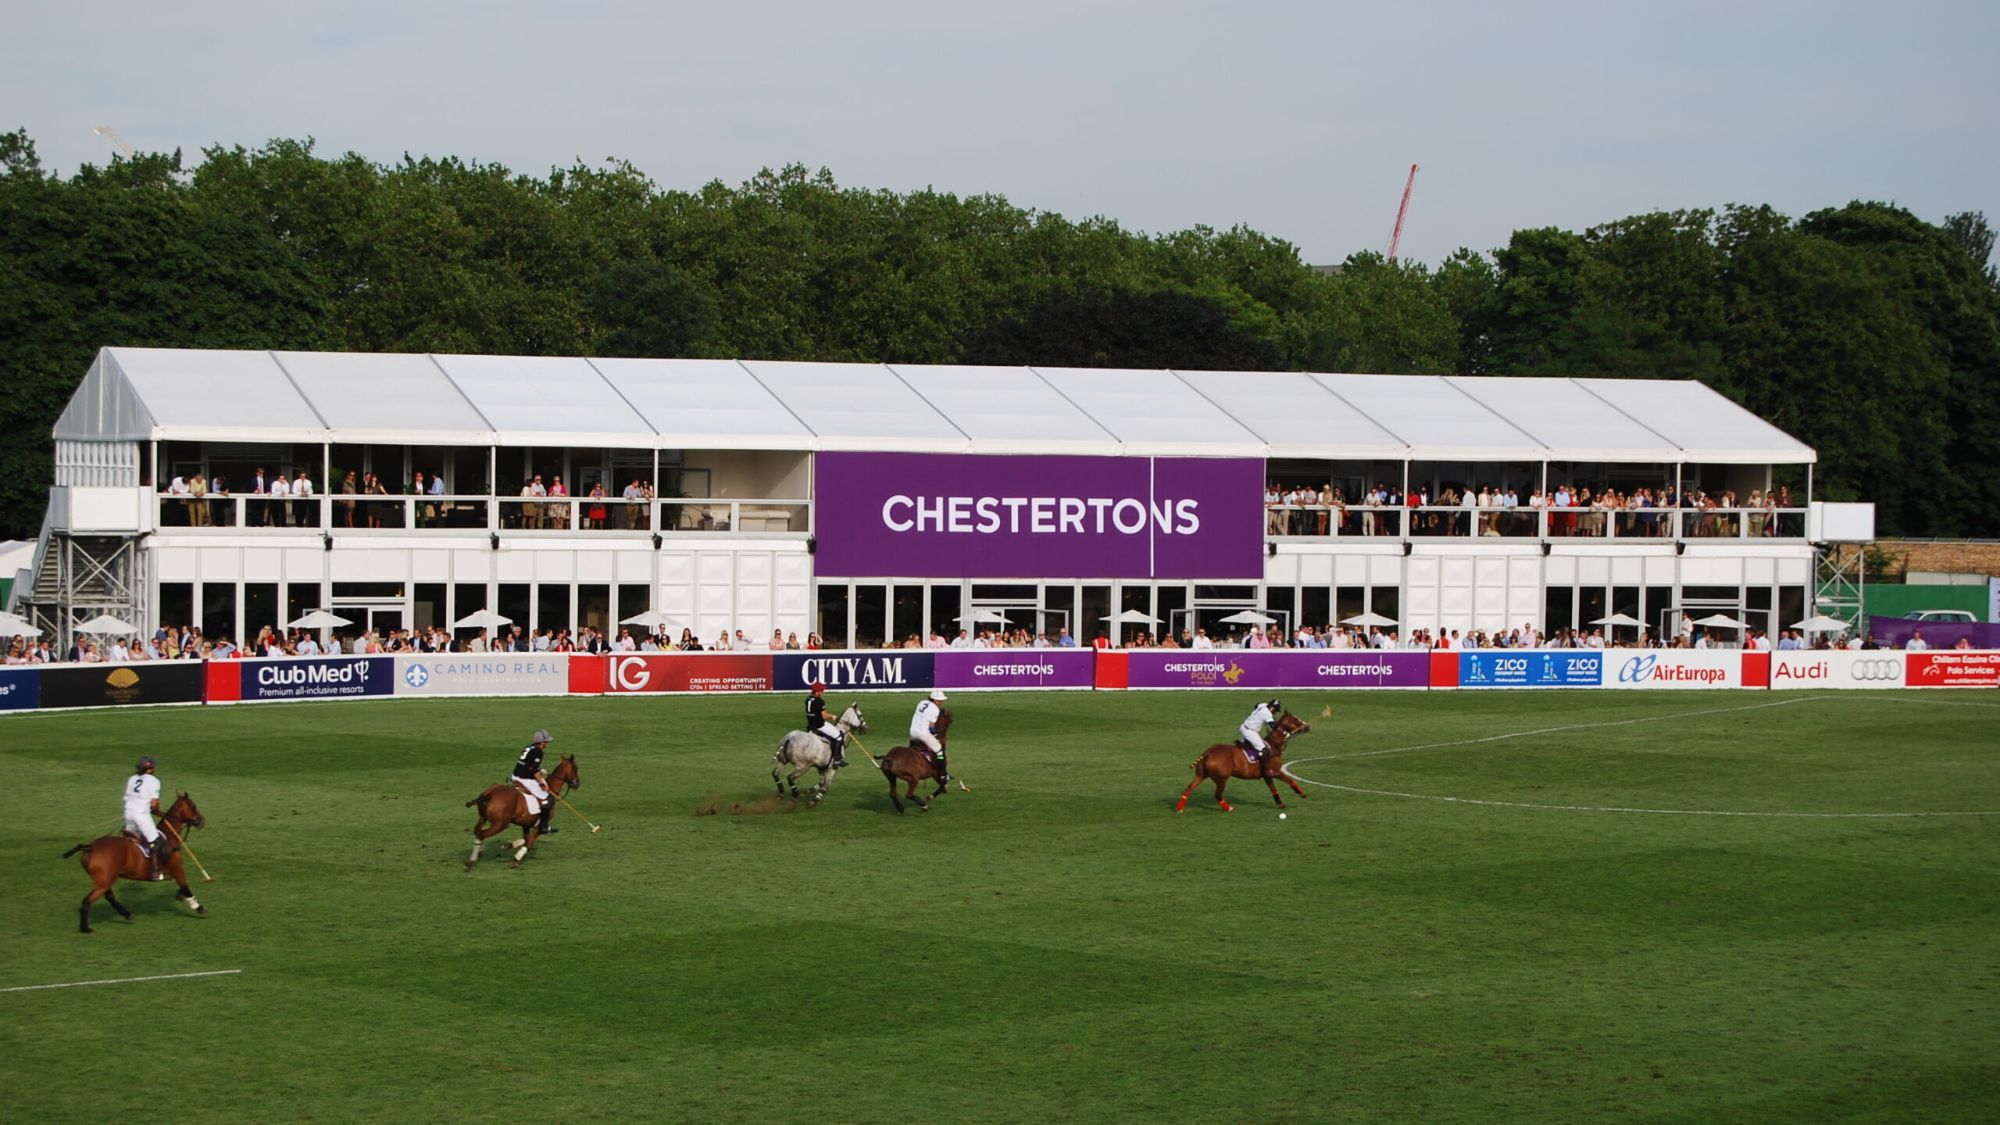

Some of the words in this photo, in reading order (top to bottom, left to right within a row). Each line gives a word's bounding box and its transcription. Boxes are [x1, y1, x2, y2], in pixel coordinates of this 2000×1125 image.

[882, 494, 1200, 535] CHESTERTONS
[434, 663, 507, 675] CAMINO
[514, 663, 560, 674] REAL
[973, 664, 1054, 676] CHESTERTONS
[1164, 663, 1226, 673] CHESTERTONS
[1317, 664, 1393, 676] CHESTERTONS
[1495, 659, 1528, 671] ZICO
[1566, 659, 1599, 671] ZICO
[1775, 661, 1828, 679] Audi
[258, 665, 306, 686] Club
[308, 663, 353, 683] Med
[609, 656, 651, 691] IG
[801, 658, 860, 686] CITY
[861, 657, 907, 684] A.M.
[259, 688, 293, 697] Premium
[295, 686, 338, 696] all-inclusive
[339, 685, 365, 694] resorts
[919, 703, 929, 713] 3
[519, 747, 531, 760] 3
[133, 779, 144, 793] 2
